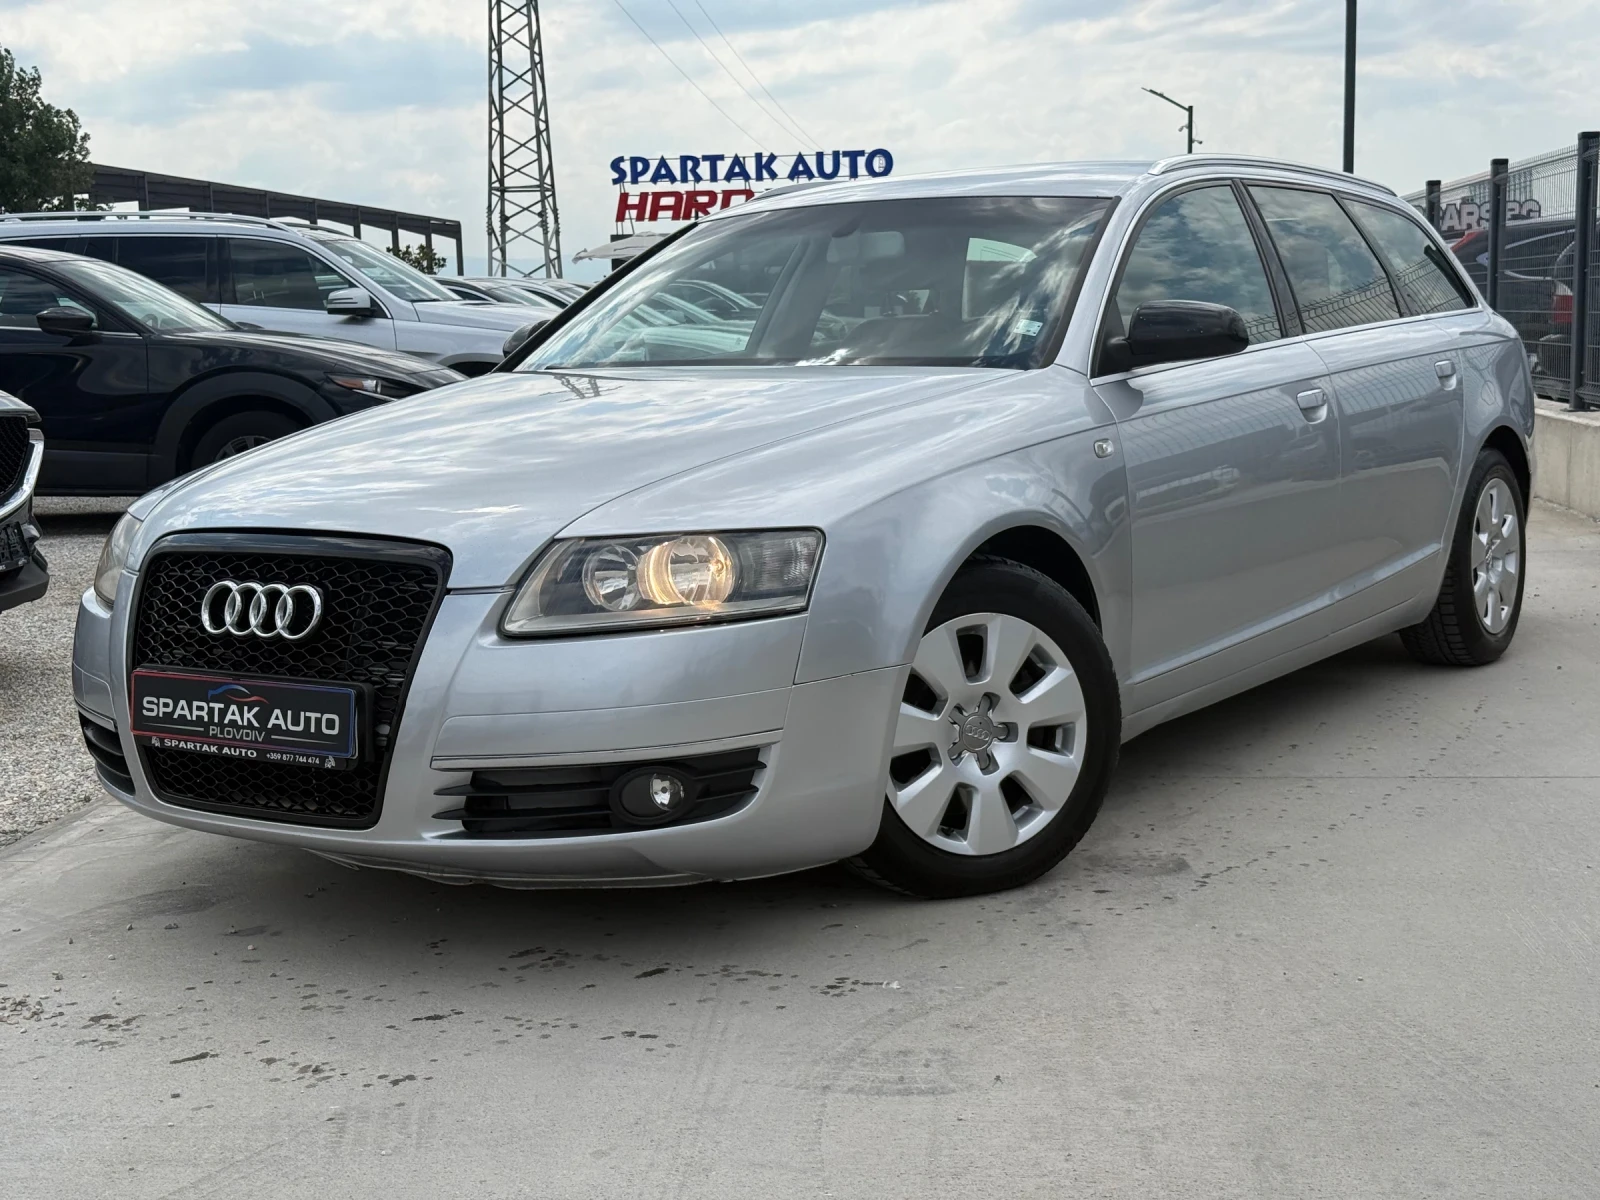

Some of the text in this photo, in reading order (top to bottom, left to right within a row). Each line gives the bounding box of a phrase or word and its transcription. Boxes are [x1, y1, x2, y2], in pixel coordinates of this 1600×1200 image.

[610, 148, 894, 185] SPARTAK AUTO
[142, 697, 340, 736] SPARTAK AUTO
[209, 726, 266, 742] PLOVDIV
[164, 738, 320, 765] SPARTAK AUTO +359 877 744 474
